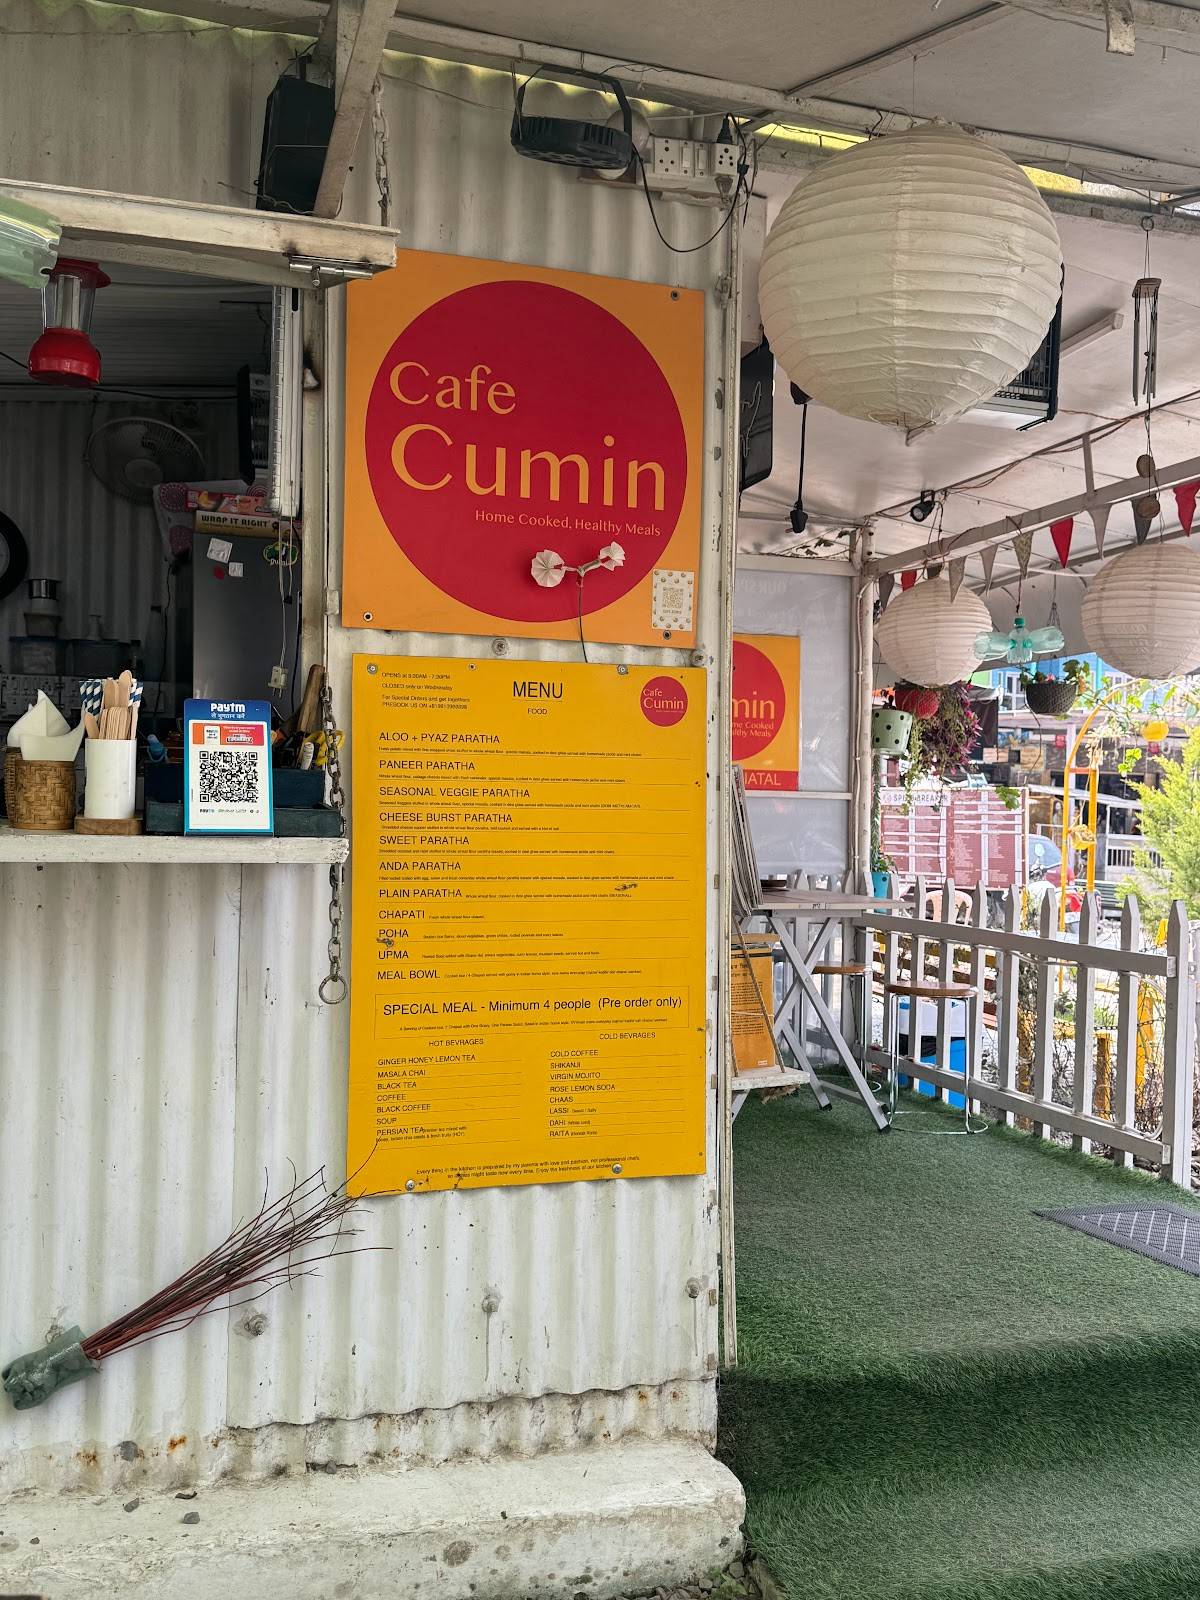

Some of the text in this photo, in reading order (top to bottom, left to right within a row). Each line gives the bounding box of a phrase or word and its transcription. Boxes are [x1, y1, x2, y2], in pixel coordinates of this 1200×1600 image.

[390, 361, 516, 414] Cafe
[391, 423, 665, 511] Cumin
[202, 515, 227, 523] WRAP
[241, 519, 268, 528] RIGHT
[475, 510, 514, 524] Home
[575, 519, 622, 535] Healthy
[626, 523, 661, 537] Meals
[513, 681, 563, 698] MENU
[643, 688, 662, 697] Cafe
[643, 698, 684, 709] Cumin
[379, 732, 408, 741] ALOO
[421, 733, 448, 742] PYAZ
[452, 734, 499, 743] PARATHA
[380, 760, 475, 770] PANEER PARATHA
[380, 787, 530, 797] SEASONAL VEGGIE PARATHA
[380, 813, 512, 822] CHEESE BURST PARATHA
[380, 836, 469, 844] SWEET PARATHA
[380, 862, 461, 870] ANDA PARATHA
[380, 889, 409, 898] PLAIN
[414, 889, 462, 897] PARATHA
[379, 910, 424, 919] CHAPATI
[379, 929, 409, 938] POHA
[378, 950, 409, 959] UPMA
[378, 971, 406, 980] MEAL
[410, 970, 440, 979] BOWL
[384, 1004, 438, 1015] SPECIAL
[443, 1002, 477, 1013] MEAL
[489, 1000, 539, 1011] Minimum
[544, 1000, 550, 1009] 4
[554, 998, 590, 1011] people
[599, 998, 620, 1010] (Pre
[625, 997, 652, 1007] order
[656, 997, 681, 1008] only)
[445, 1038, 484, 1046] BEVRAGES
[403, 1104, 431, 1112] COFFEE
[377, 1128, 408, 1136] PERSIAN
